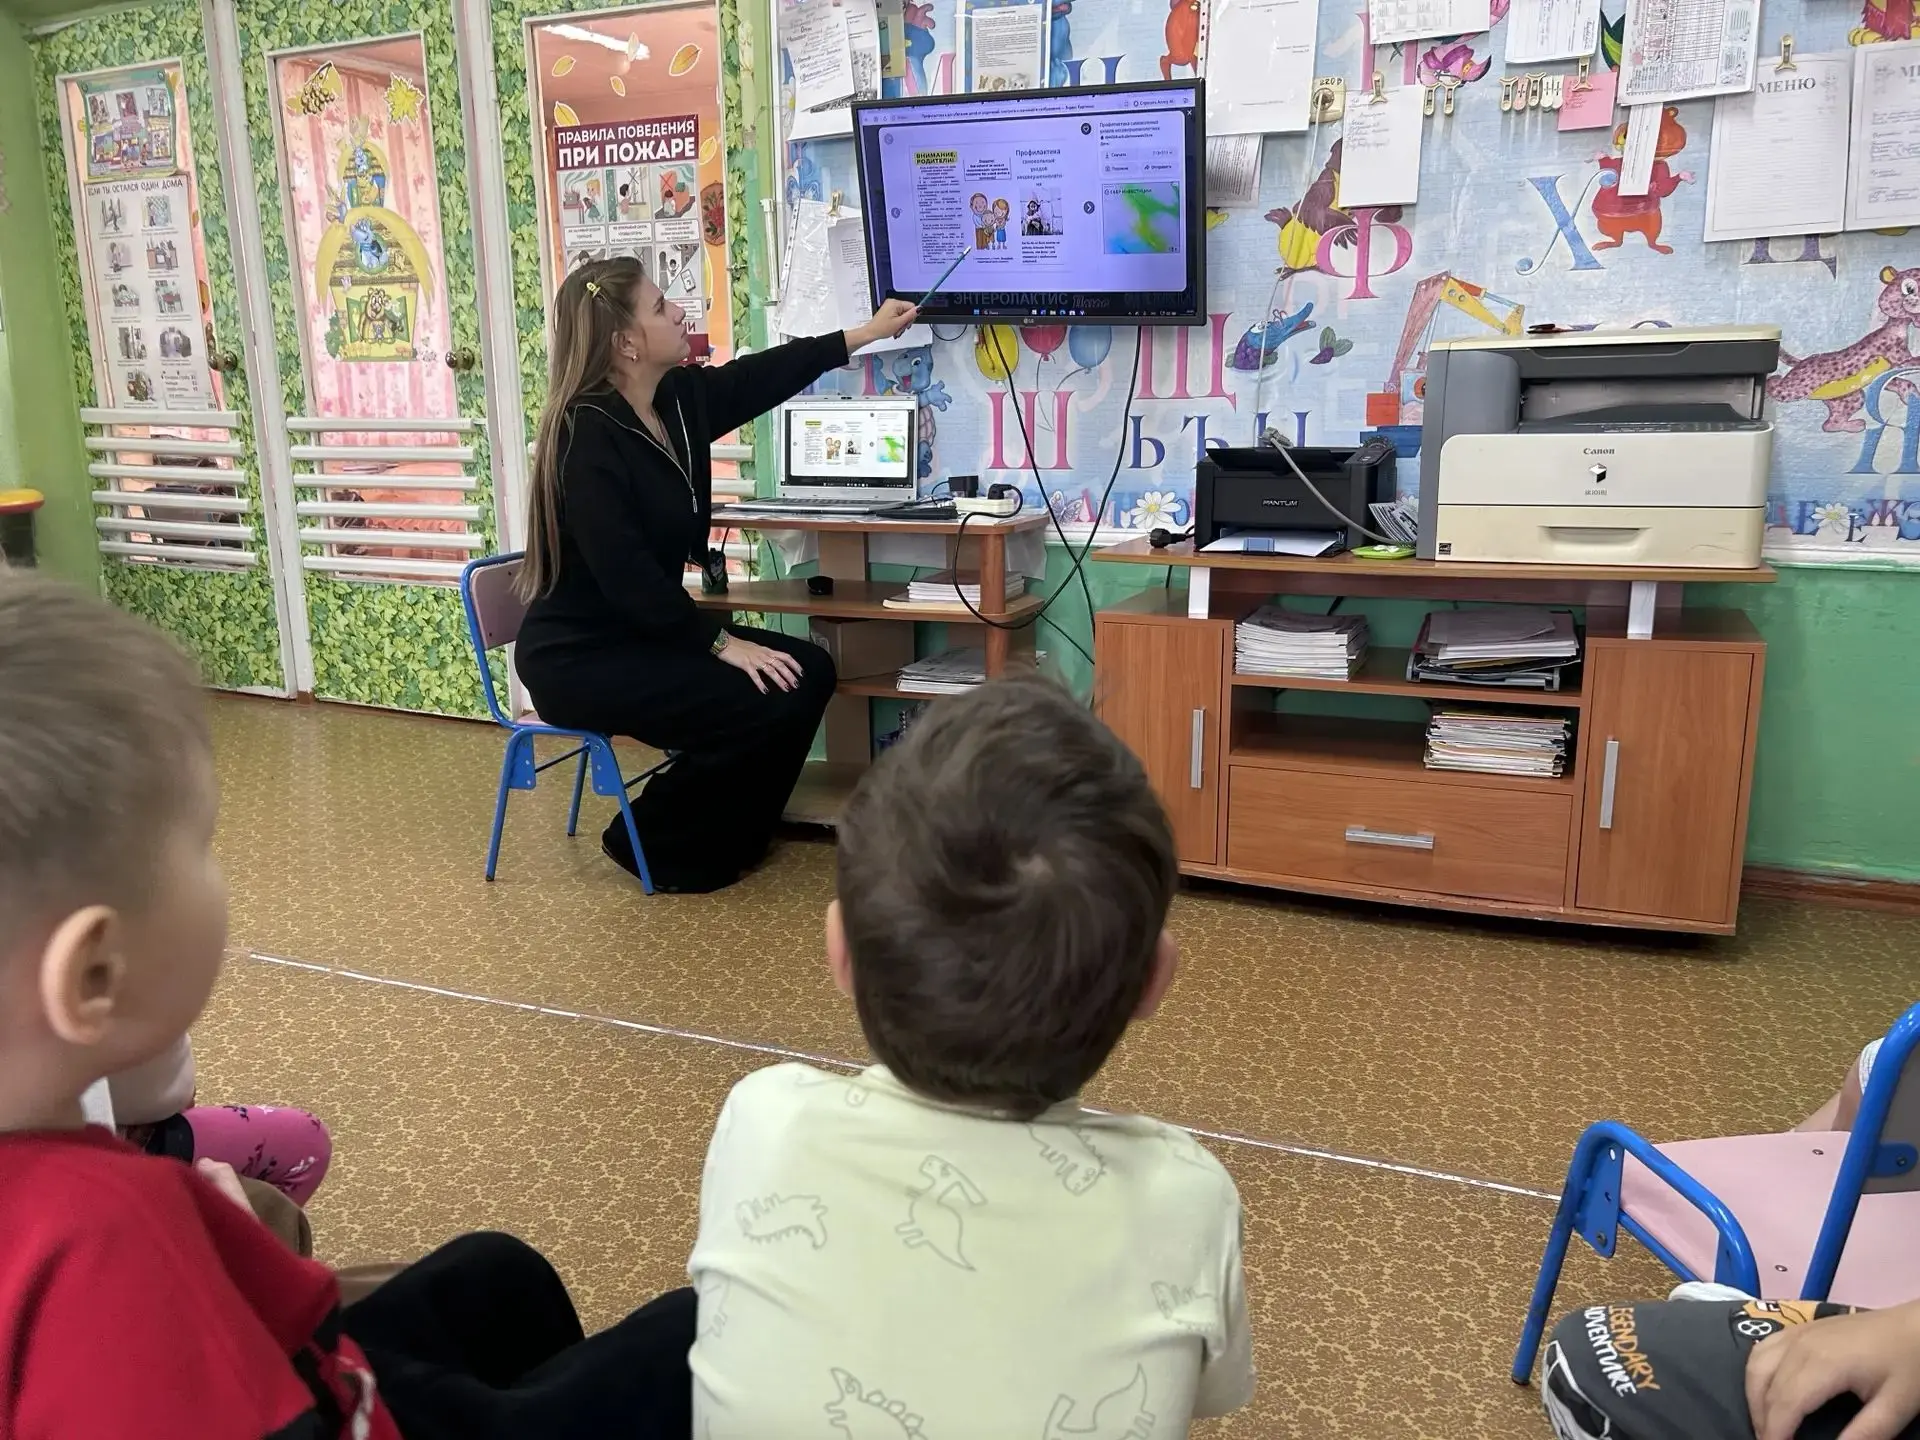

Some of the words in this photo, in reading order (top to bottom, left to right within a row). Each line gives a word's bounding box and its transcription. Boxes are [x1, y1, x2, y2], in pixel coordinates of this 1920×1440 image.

[1758, 77, 1816, 93] МЕНЮ
[558, 126, 615, 145] ПРАВИЛА
[617, 119, 695, 140] ПОВЕДЕНИЯ
[559, 146, 600, 168] ПРИ
[605, 137, 695, 163] ПОЖАРЕ
[1015, 148, 1061, 157] Профилактика
[102, 185, 110, 194] ТЫ
[112, 183, 139, 192] ОСТАЛСЯ
[141, 181, 160, 191] ОДИН
[162, 179, 183, 189] ДОМА
[953, 292, 1068, 306] ЭНТЕРОЛАКТИС
[1583, 447, 1615, 455] Canon
